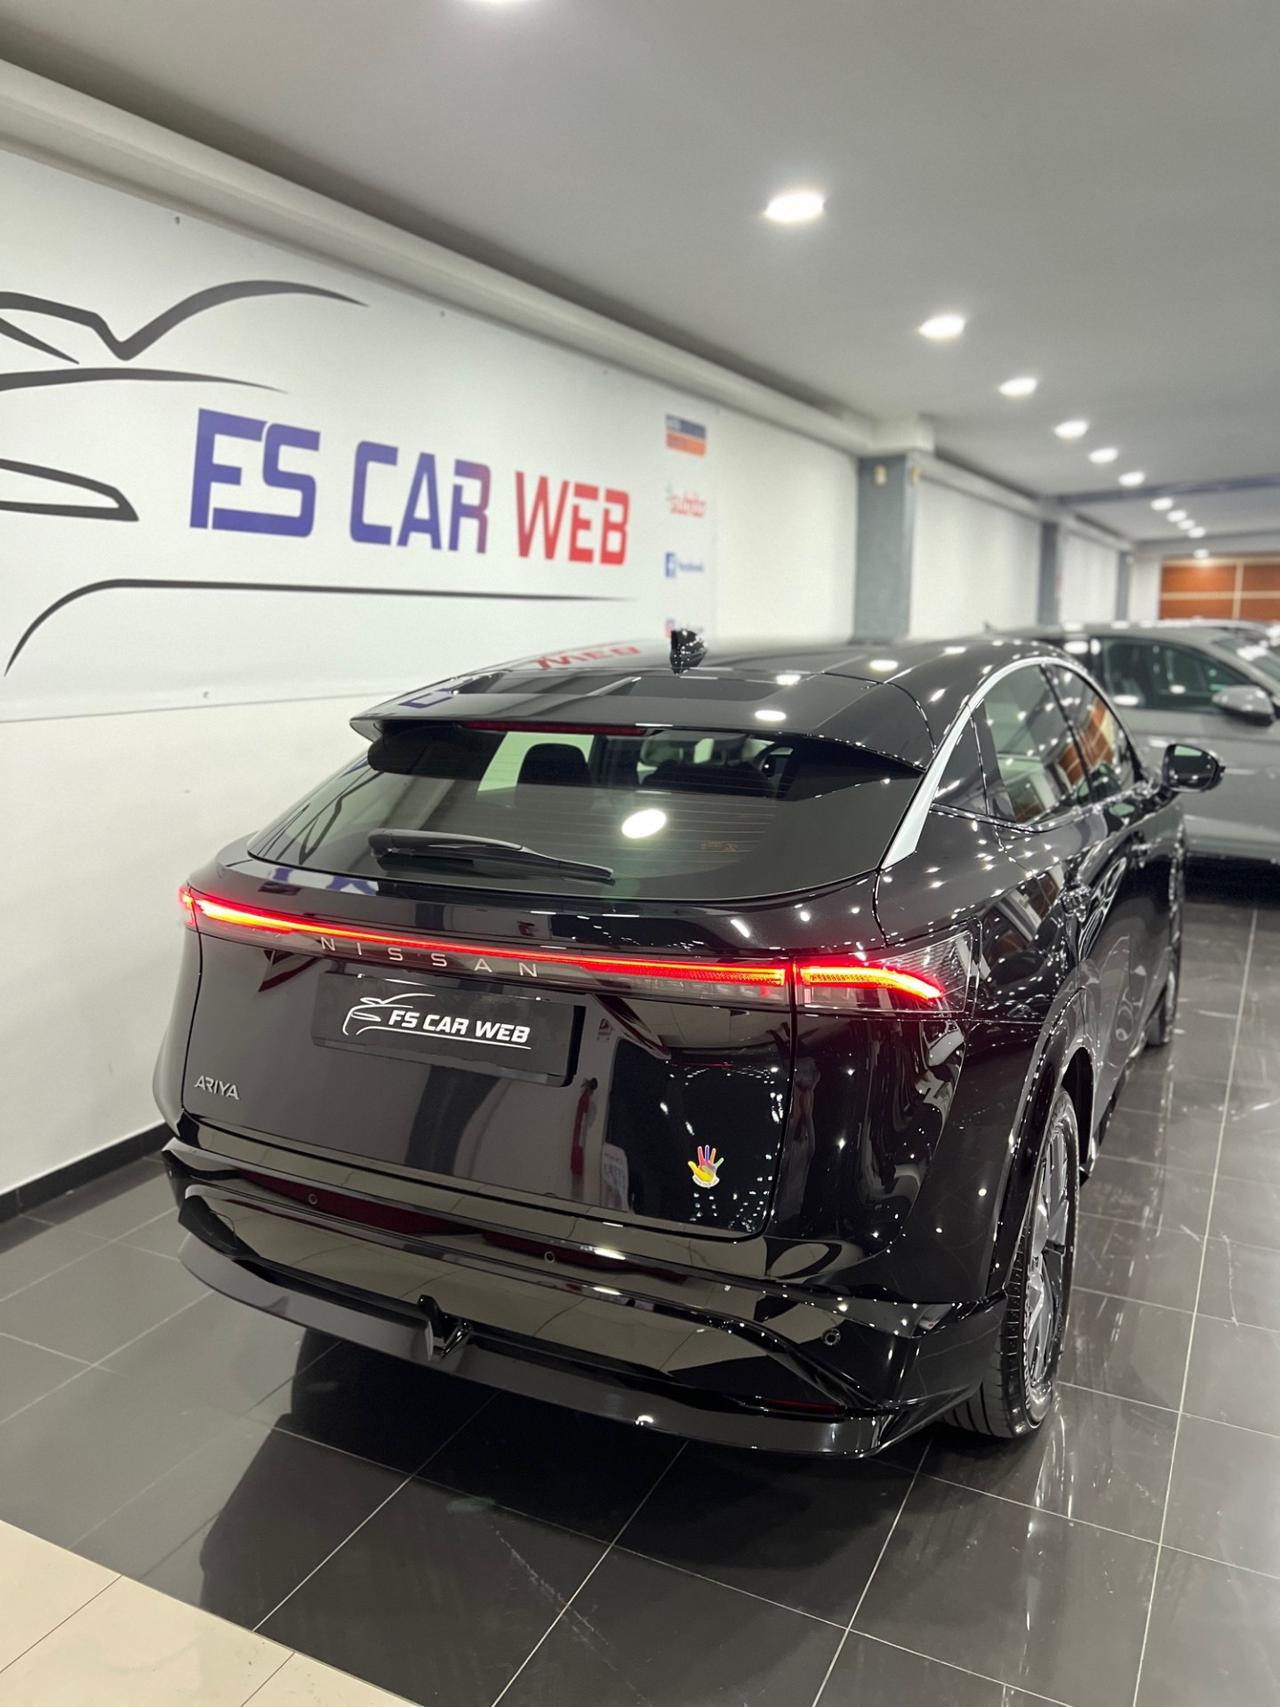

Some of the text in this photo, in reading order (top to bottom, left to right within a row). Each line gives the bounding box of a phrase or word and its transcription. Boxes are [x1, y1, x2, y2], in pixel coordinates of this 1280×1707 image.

[350, 440, 491, 554] CAR
[515, 471, 630, 566] WEB
[319, 936, 538, 978] NISSAN
[388, 1009, 531, 1044] FS CAR WEB
[194, 1074, 240, 1101] ARIYA
